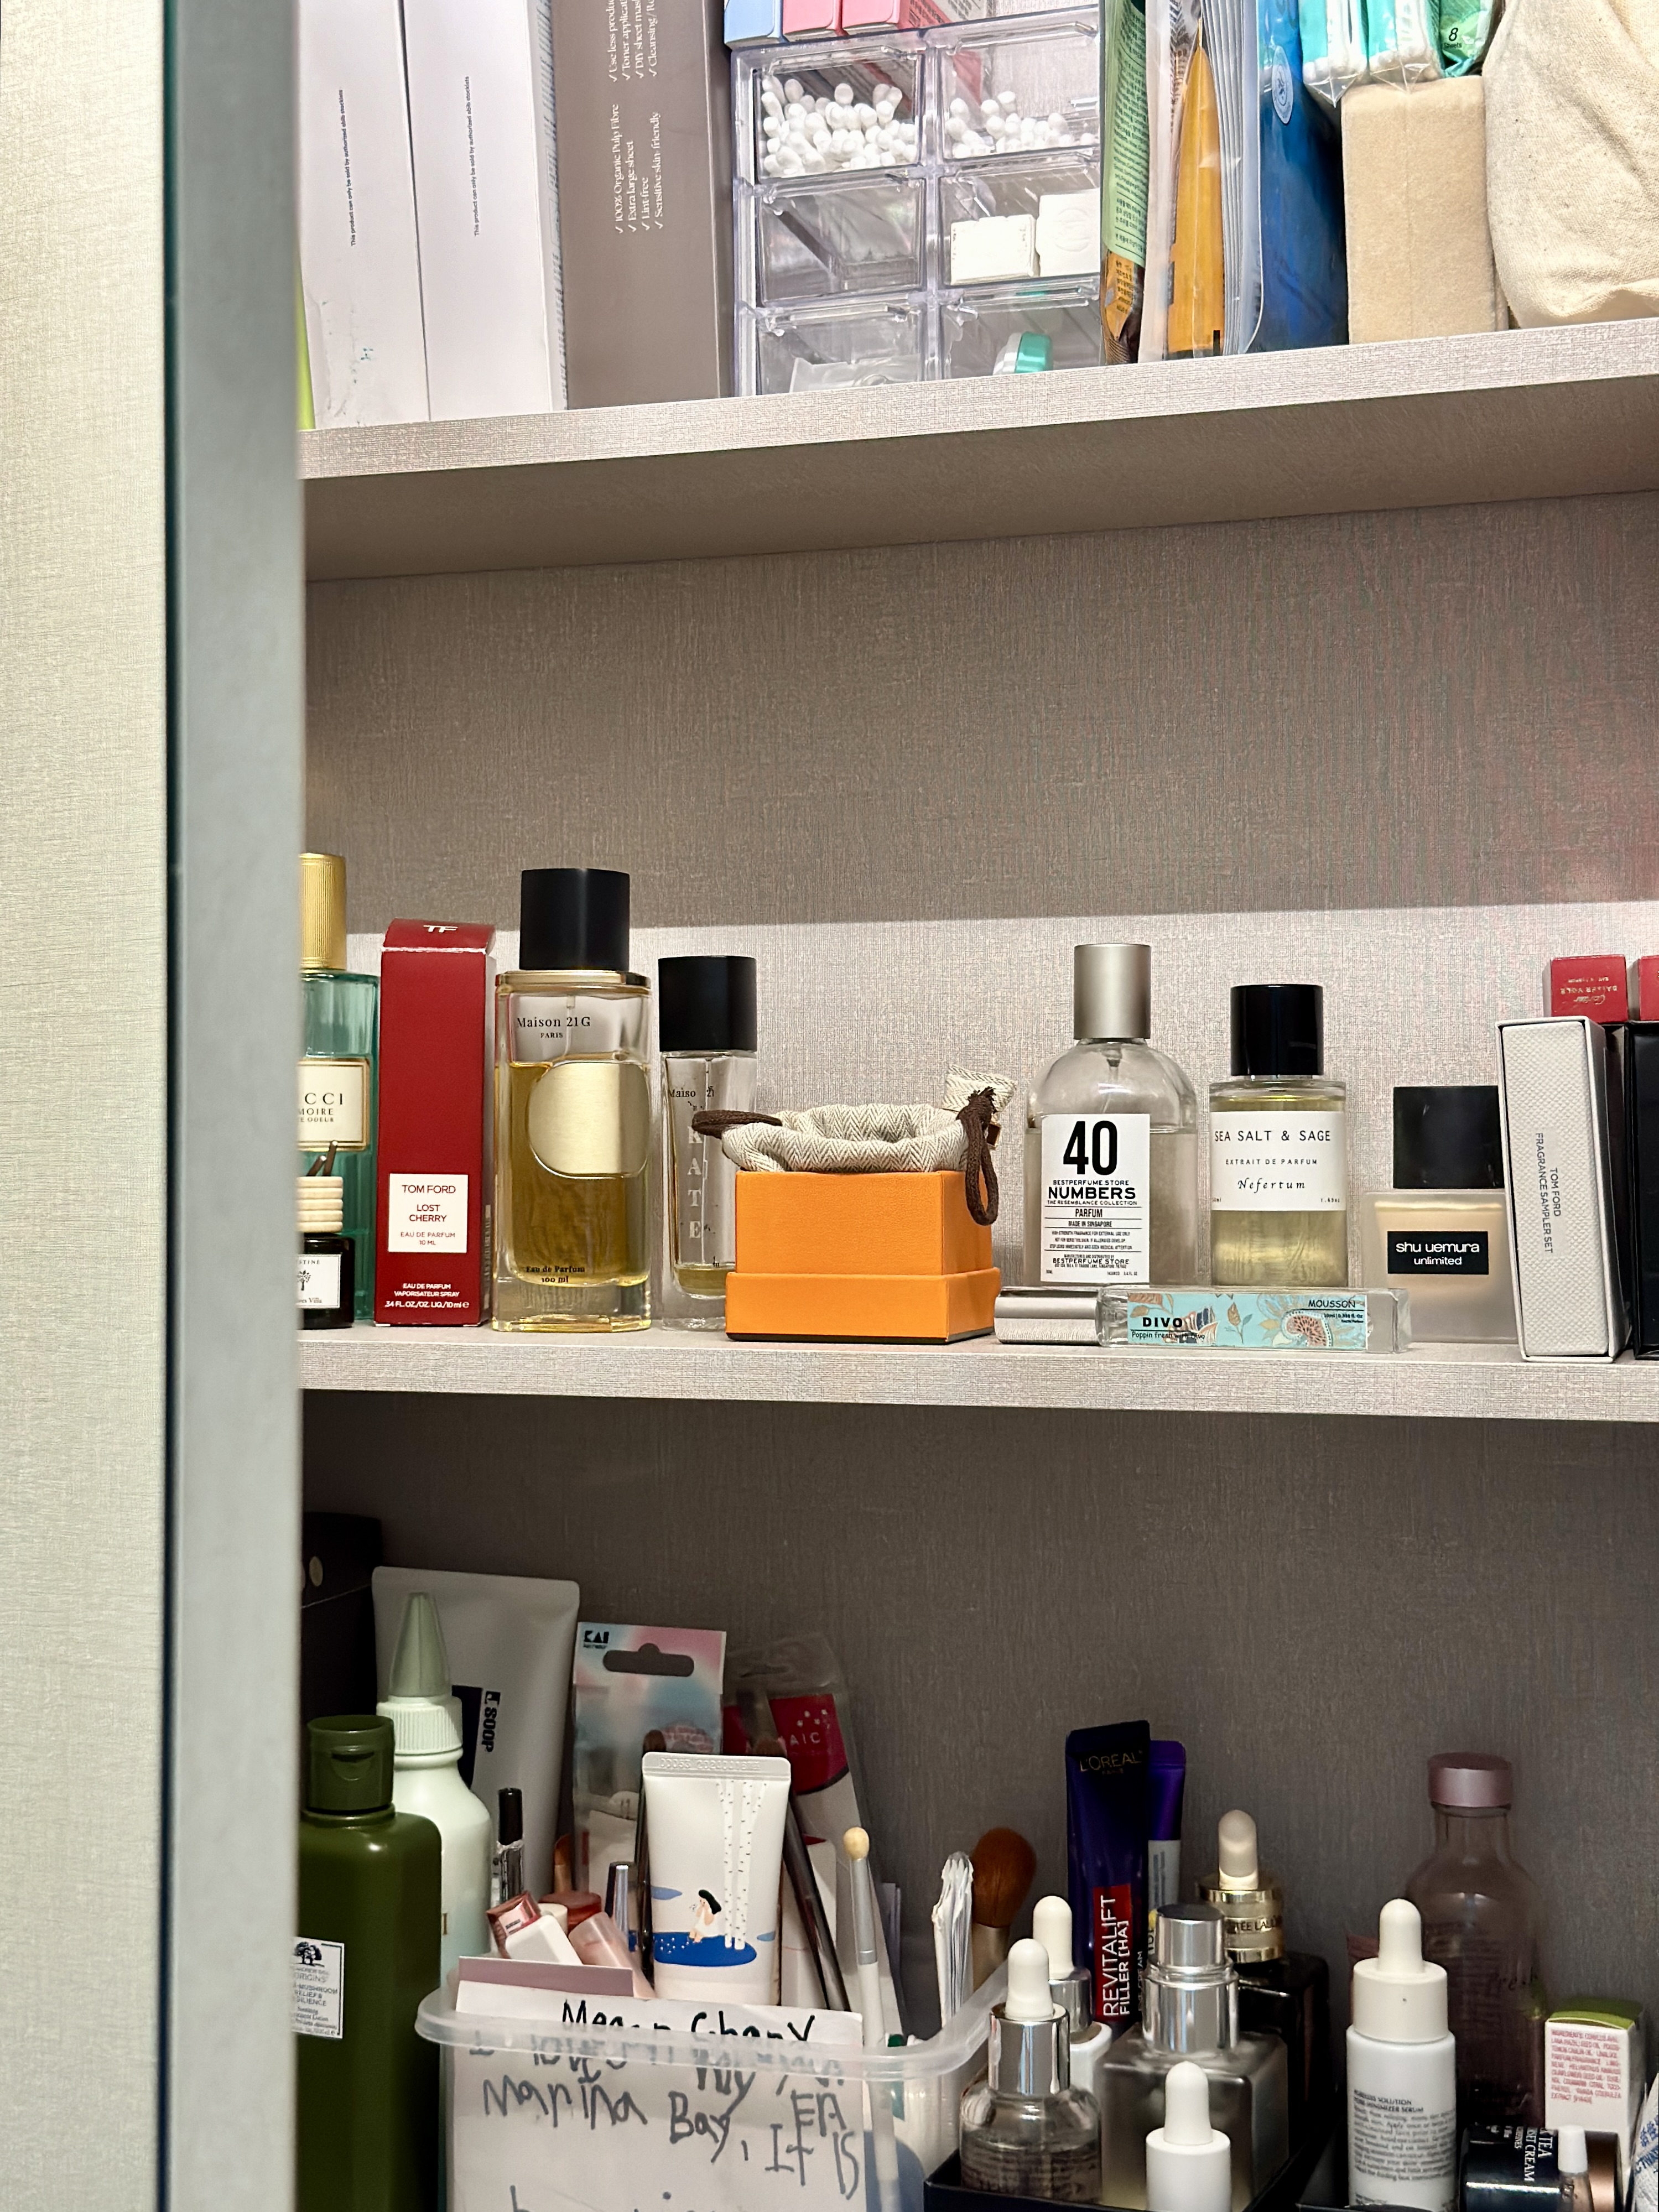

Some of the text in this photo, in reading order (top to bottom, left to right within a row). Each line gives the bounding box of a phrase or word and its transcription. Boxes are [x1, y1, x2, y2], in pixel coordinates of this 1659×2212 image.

[1449, 28, 1458, 41] 8
[622, 41, 630, 71] Toner
[611, 131, 622, 153] Pulp
[613, 155, 624, 194] Organic
[654, 175, 663, 217] Sensitive
[628, 196, 637, 220] Extra
[517, 1017, 561, 1027] Maison
[1215, 1131, 1330, 1141] SEA SALT & SAGE
[1063, 1121, 1117, 1175] 40
[402, 1185, 424, 1193] TOM
[1049, 1186, 1136, 1199] NUMBERS
[1237, 1178, 1305, 1194] Nefertum
[1536, 1133, 1553, 1253] FRAGRANCE SAMPLER SET
[1550, 1168, 1561, 1217] TOM FORD
[1075, 1209, 1102, 1217] PARFUM
[1396, 1242, 1479, 1252] shu uemura
[1414, 1257, 1462, 1265] unlimited
[1143, 1317, 1183, 1328] DIVO
[1132, 1331, 1152, 1340] Poppin
[584, 1630, 609, 1643] KAI
[1100, 1895, 1120, 2016] REVITALIFT
[1117, 1920, 1130, 2016] FILLER [HA]
[1538, 2137, 1553, 2158] TEA
[1524, 2145, 1536, 2182] CREAM
